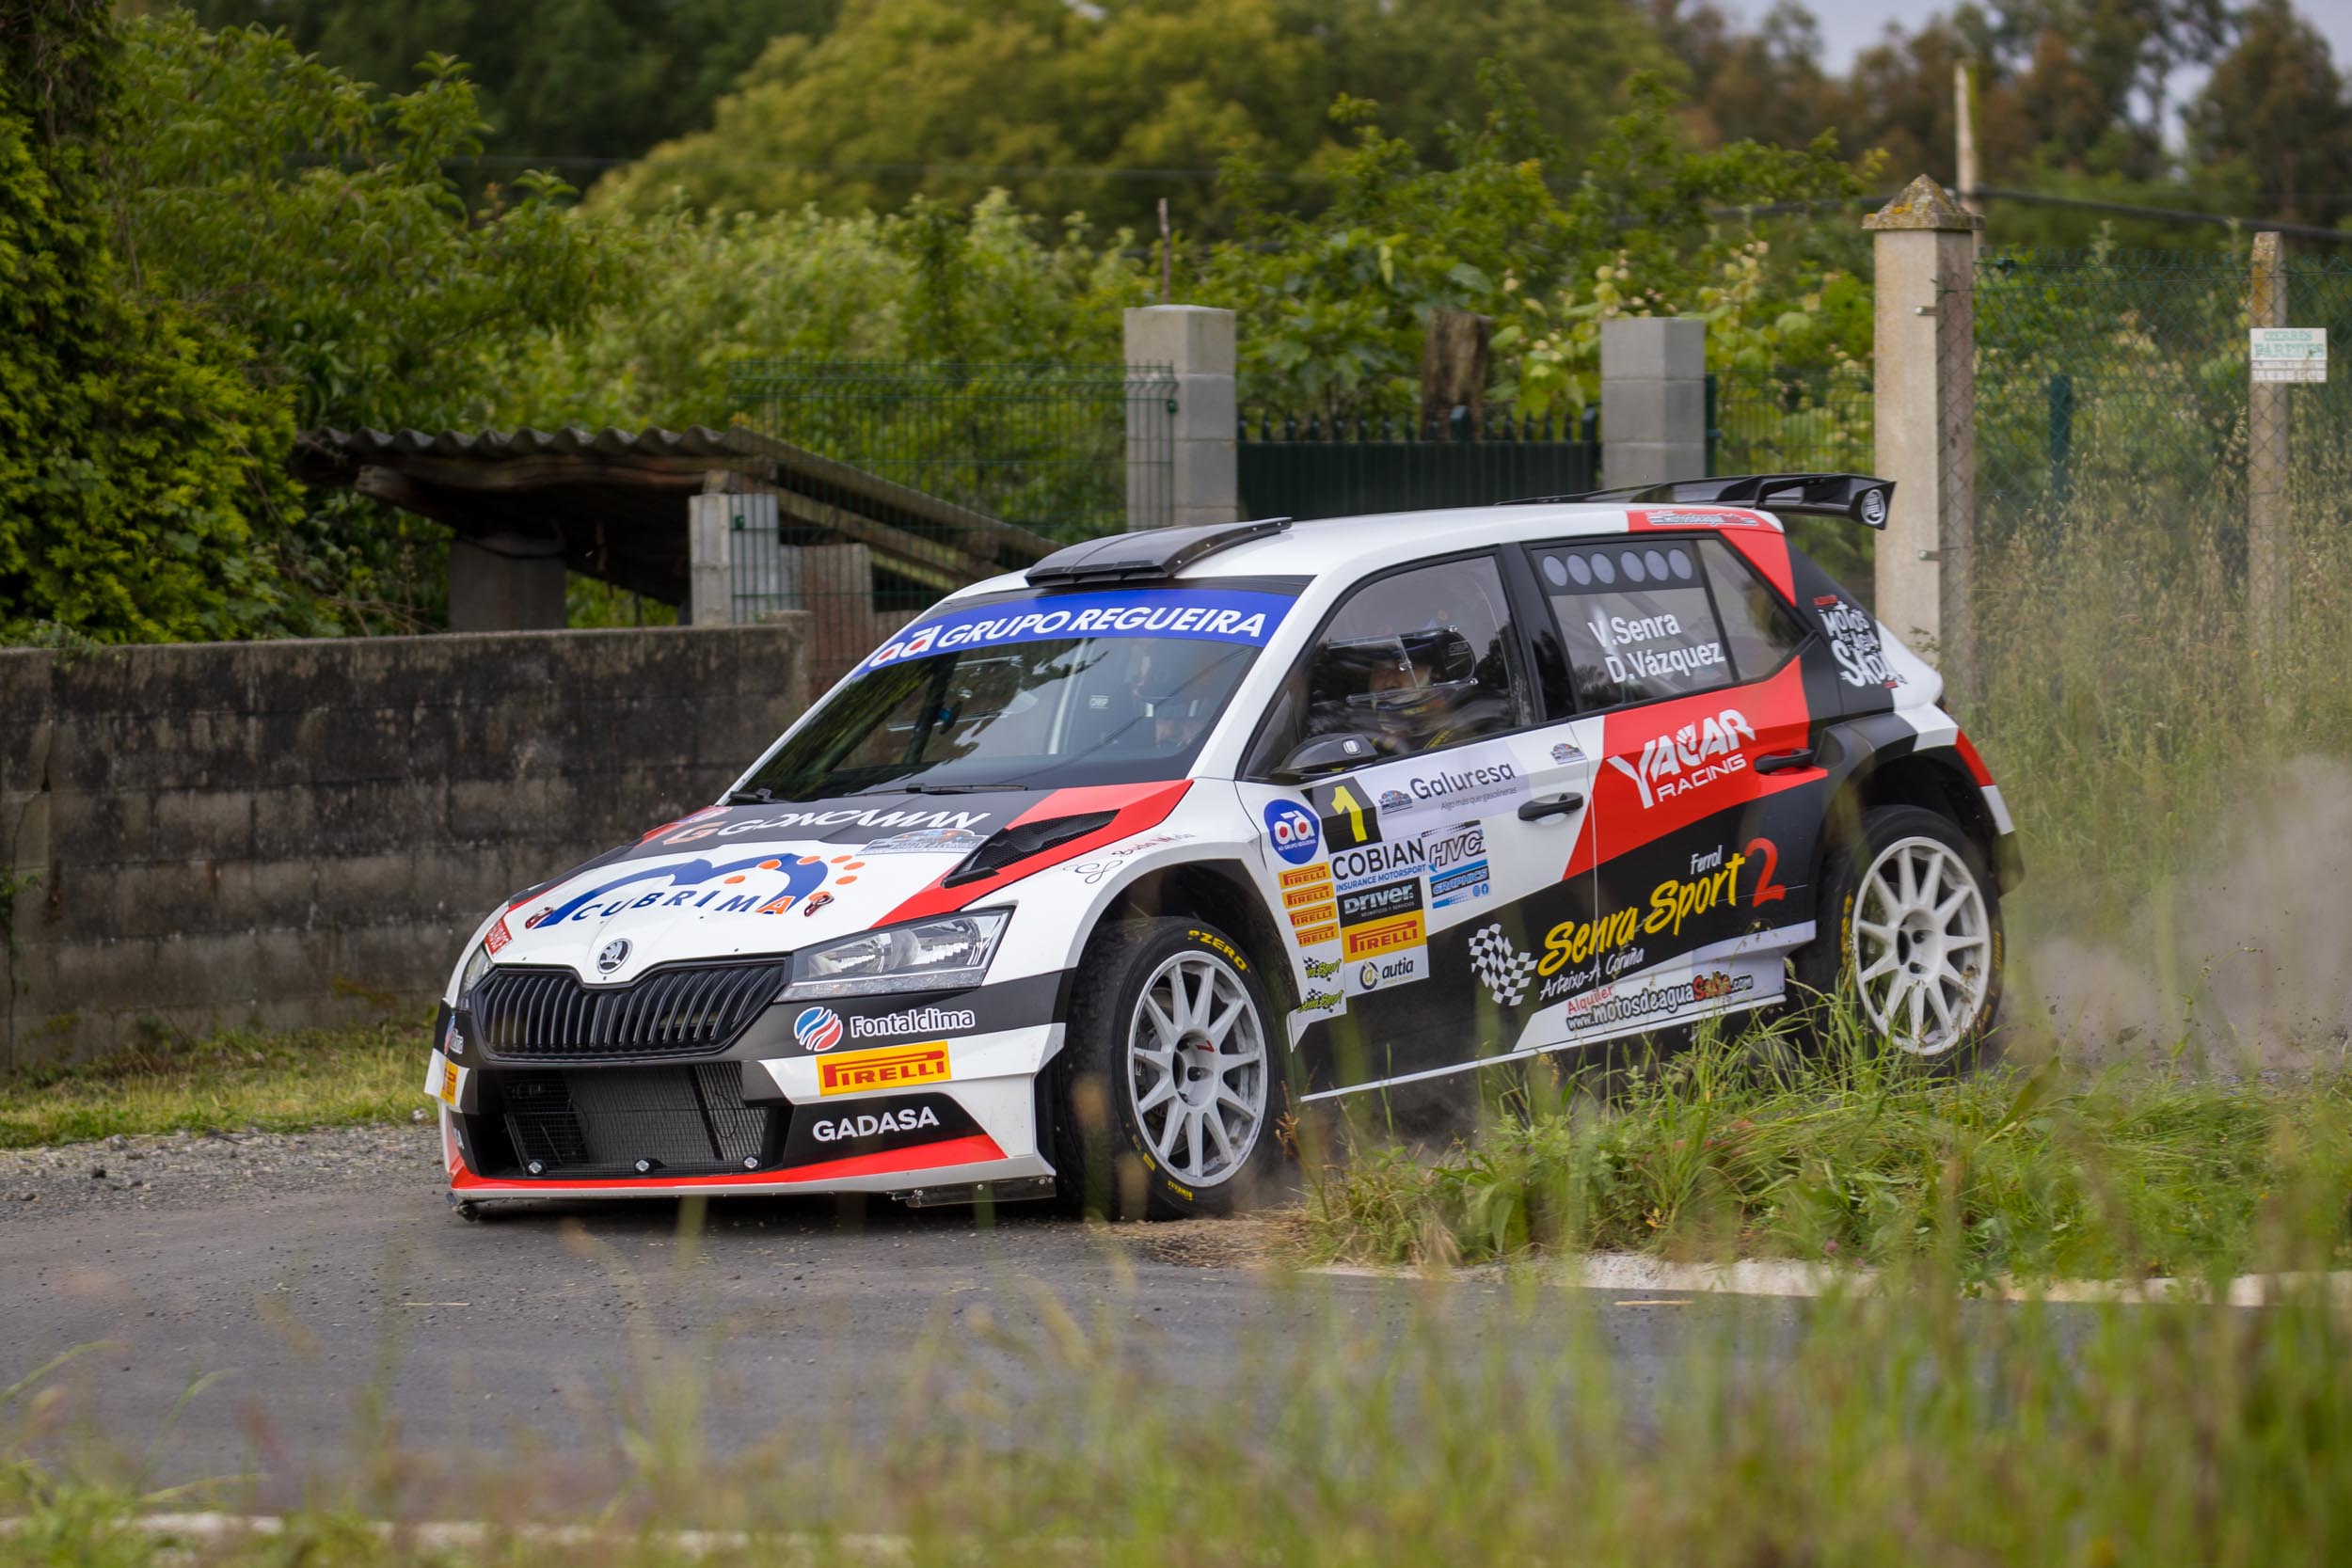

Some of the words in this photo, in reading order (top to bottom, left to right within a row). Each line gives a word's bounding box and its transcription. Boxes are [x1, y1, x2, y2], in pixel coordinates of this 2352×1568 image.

[937, 610, 1071, 648] GRUPO
[1067, 607, 1266, 638] REGUEIRA
[1409, 763, 1516, 800] Galuresa
[1658, 753, 1747, 802] RACING
[1331, 785, 1368, 843] 1
[1332, 838, 1425, 880] COBIAN
[1429, 830, 1486, 867] HVC
[1691, 845, 1723, 876] Ferrol
[1283, 865, 1326, 886] PIRELLI
[1336, 876, 1376, 893] INSURANCE
[1378, 864, 1426, 882] MOTORSPORT
[1433, 869, 1488, 895] GRAPHICS
[571, 890, 796, 922] CUBRIMA
[1287, 885, 1329, 906] PIRELLI
[1537, 907, 1639, 976] Senra
[1645, 853, 1745, 936] Sport
[1744, 837, 1786, 908] 2
[1349, 920, 1418, 954] PIRELLI
[1382, 957, 1414, 979] autia
[1539, 964, 1600, 1001] Arteixo-A
[1567, 985, 1613, 1015] Alquiler
[850, 1008, 976, 1037] Fontalclima
[822, 1050, 945, 1088] PIRELLI
[812, 1105, 940, 1142] GADASA
